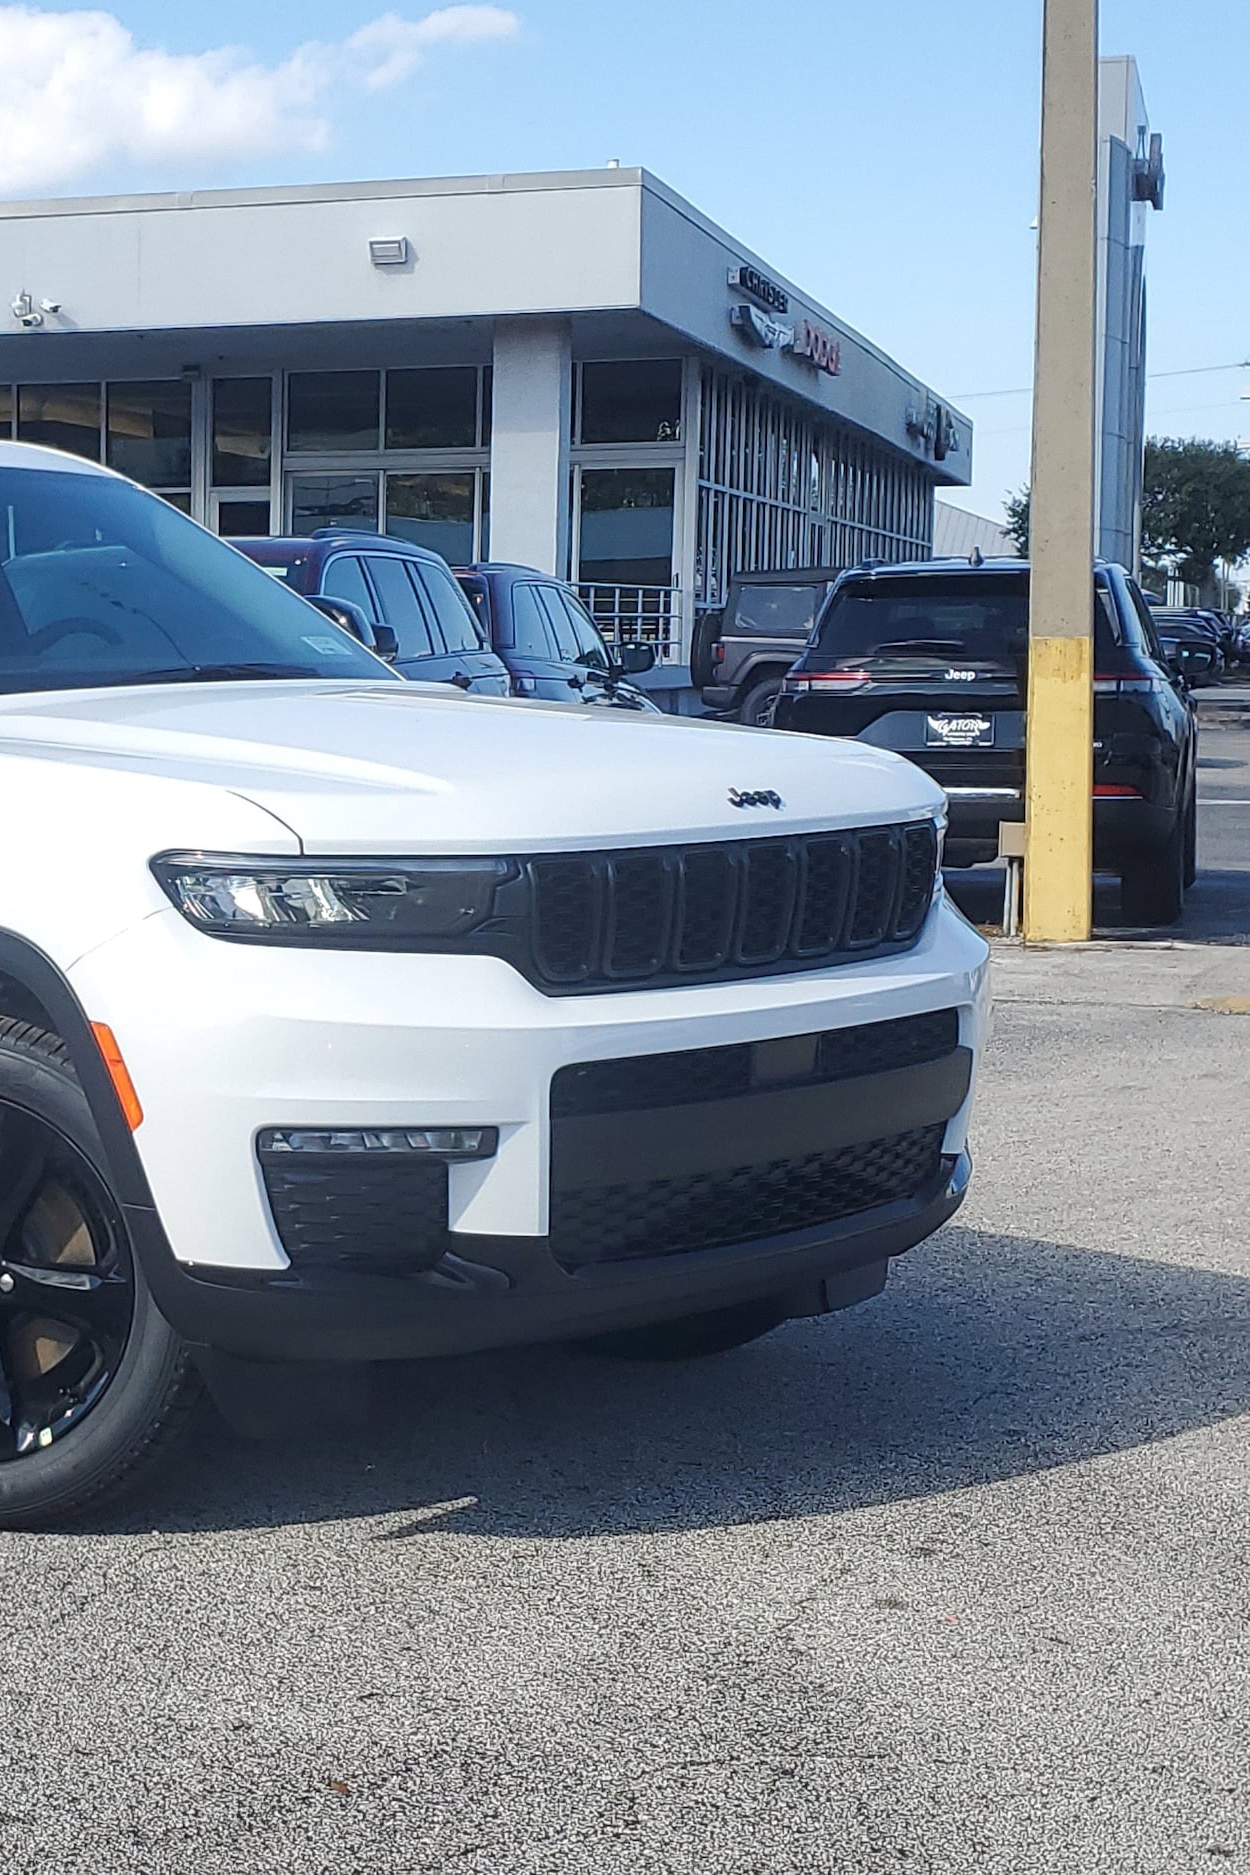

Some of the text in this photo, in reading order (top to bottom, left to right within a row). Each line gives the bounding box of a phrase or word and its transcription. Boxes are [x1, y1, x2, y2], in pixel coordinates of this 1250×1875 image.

[944, 668, 976, 682] Jeep
[938, 719, 981, 737] GATOR
[727, 787, 782, 810] Jeep
